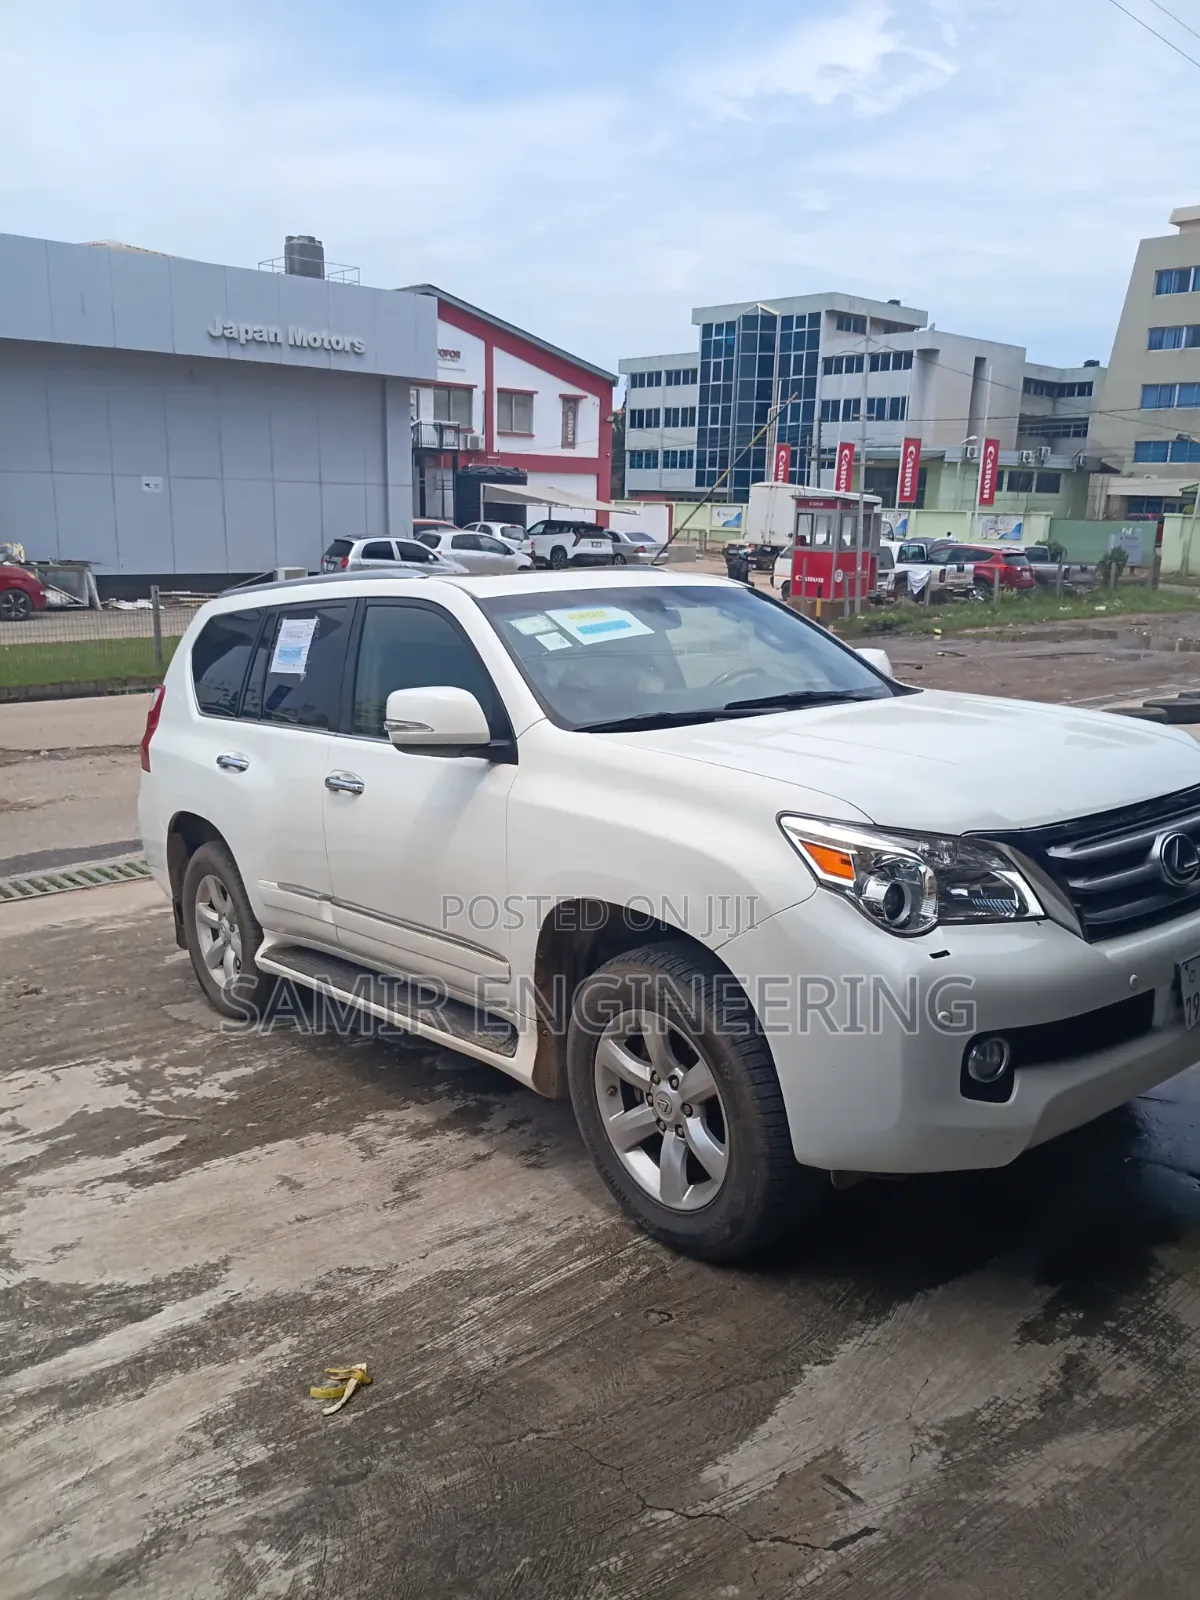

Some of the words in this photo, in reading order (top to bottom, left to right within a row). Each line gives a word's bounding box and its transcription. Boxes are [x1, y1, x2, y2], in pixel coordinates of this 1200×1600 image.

[207, 316, 282, 344] Japan
[288, 324, 365, 354] Motors
[777, 450, 787, 484] Can
[903, 445, 916, 496] Canon
[982, 446, 995, 499] Canon
